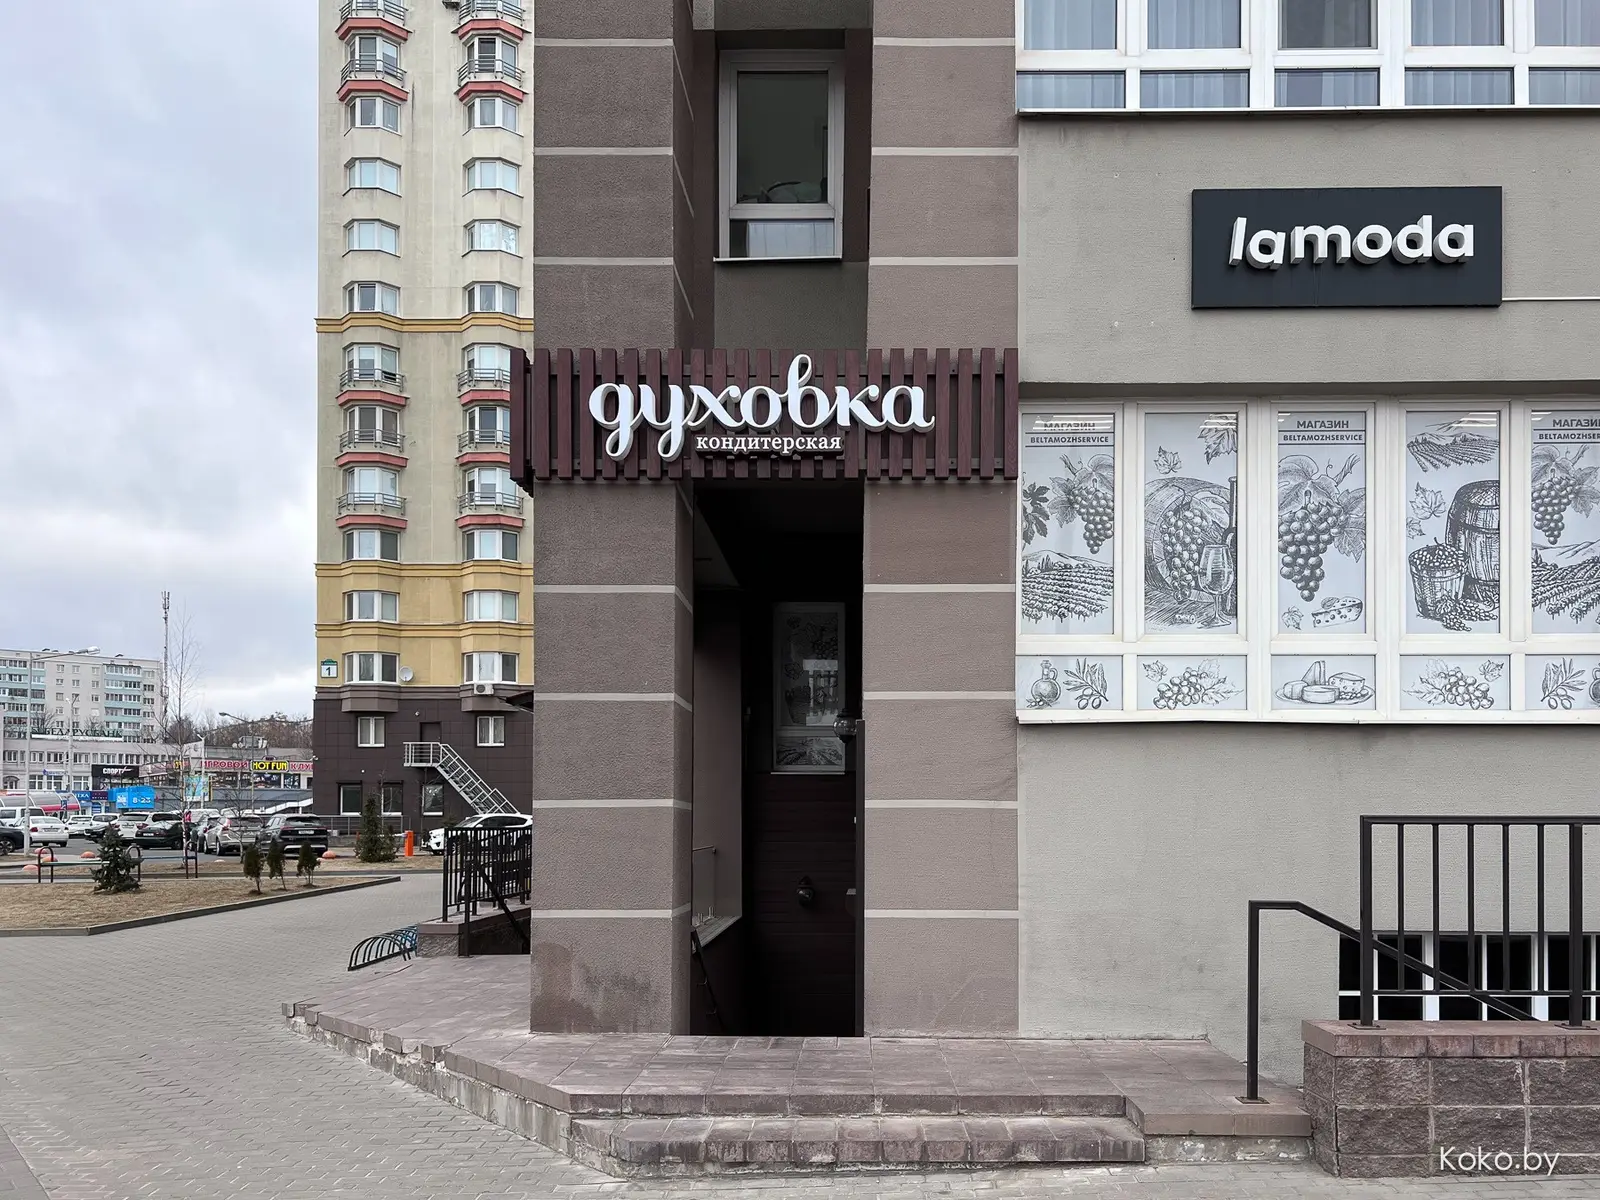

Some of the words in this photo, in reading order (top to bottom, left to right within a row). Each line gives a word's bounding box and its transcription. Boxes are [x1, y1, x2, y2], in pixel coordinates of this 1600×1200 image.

[1228, 214, 1474, 270] lamoda
[588, 353, 935, 462] духовка
[1296, 420, 1349, 429] МАГАЗИН
[696, 434, 842, 454] кондитерская
[1030, 436, 1109, 444] BELTAMOZHSERVICE
[325, 666, 331, 677] 1
[252, 761, 270, 770] HOT
[271, 761, 287, 770] FUN
[291, 762, 313, 770] КЛУ
